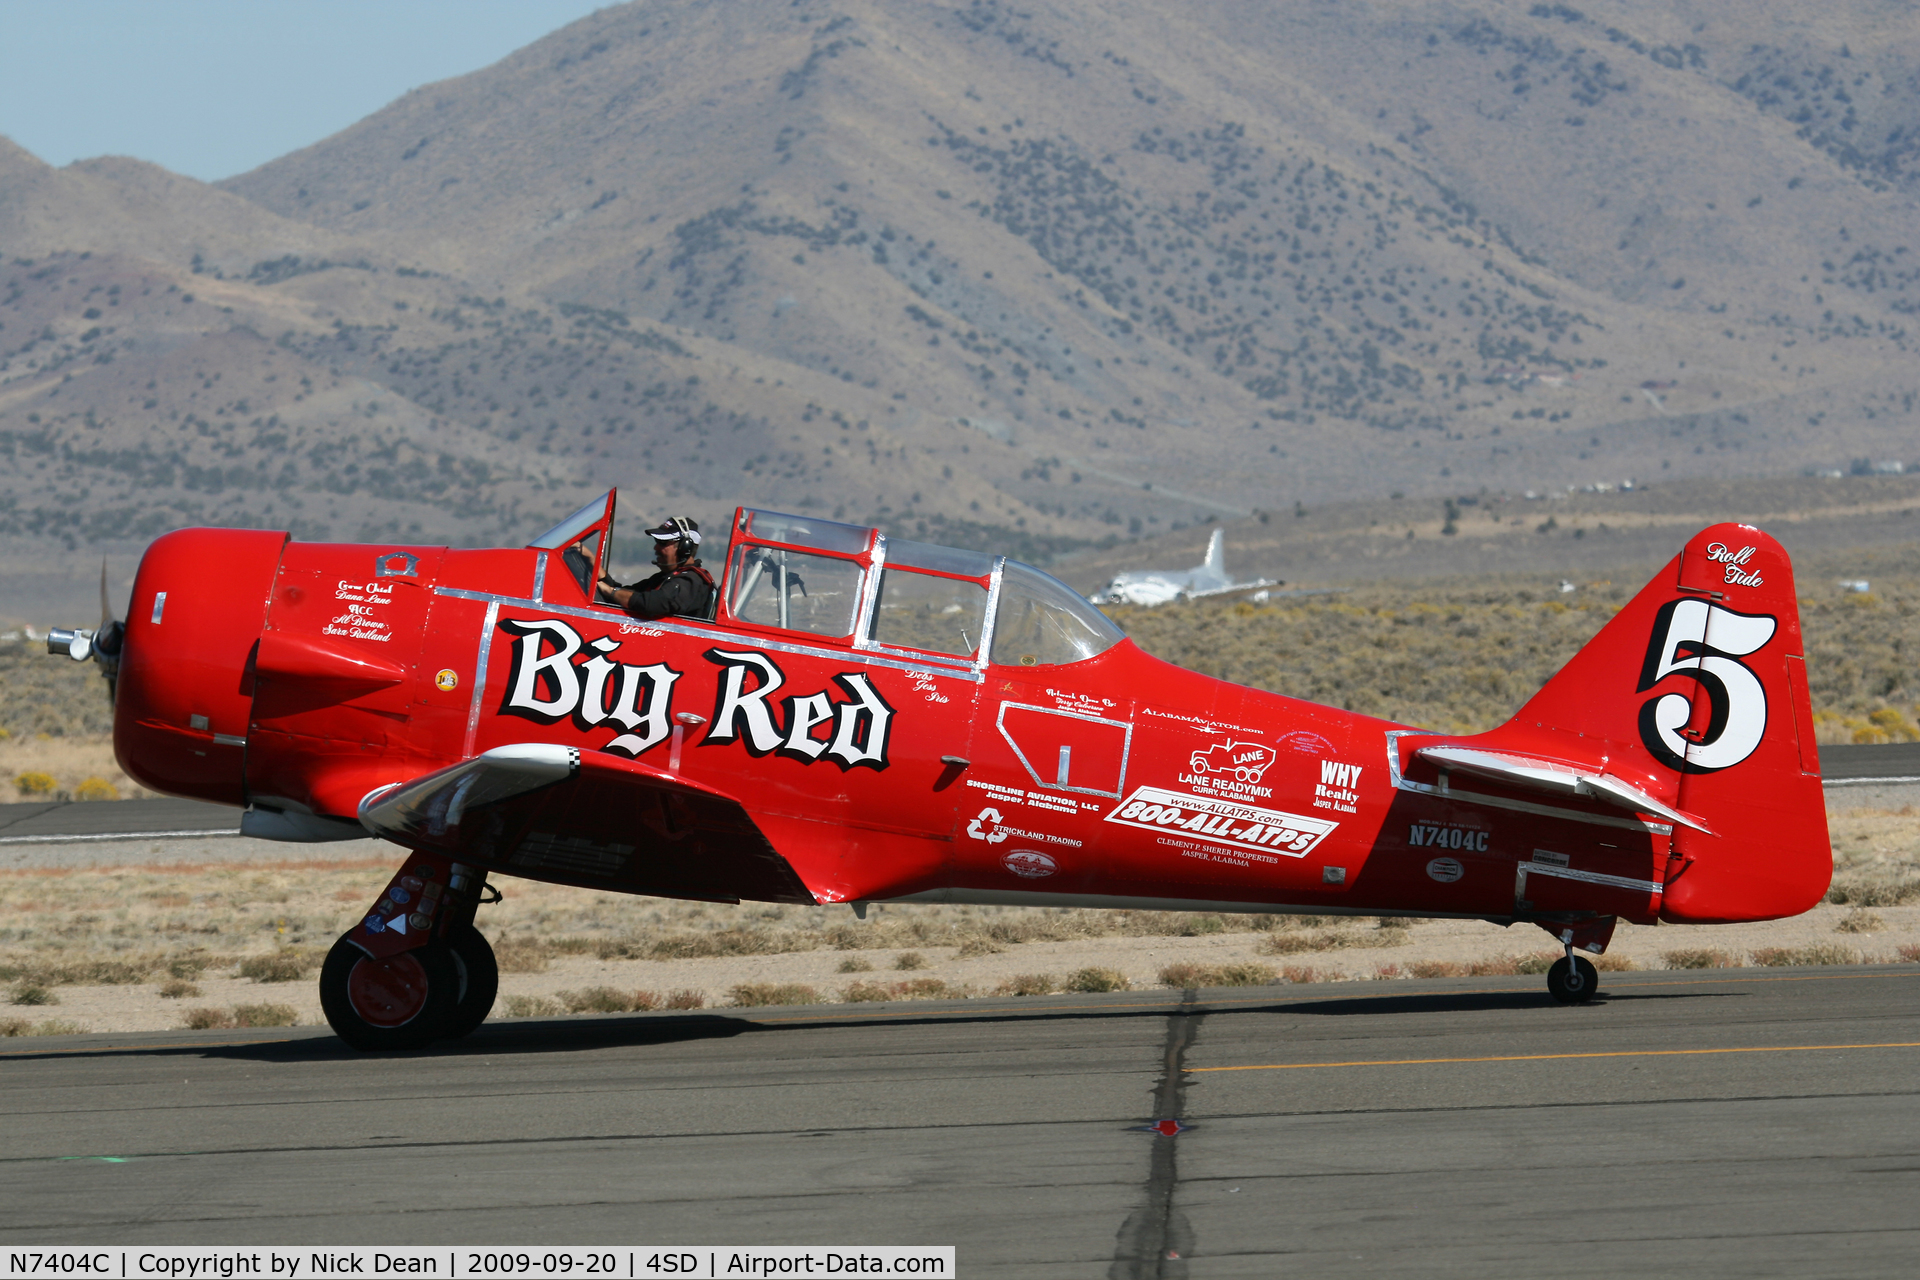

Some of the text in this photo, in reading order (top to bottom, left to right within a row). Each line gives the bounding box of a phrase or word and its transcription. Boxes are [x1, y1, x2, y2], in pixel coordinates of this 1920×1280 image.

[1707, 542, 1757, 566] Roll
[1724, 563, 1764, 587] Tide
[335, 590, 391, 604] Dana Lane
[366, 583, 393, 594] Chief
[348, 604, 373, 616] ACC
[351, 615, 385, 629] Brown
[619, 621, 665, 637] Gordo
[322, 624, 392, 642] Sara Rutland
[904, 669, 934, 681] Debs
[912, 680, 937, 691] Jess
[1638, 598, 1777, 772] 5
[500, 618, 895, 770] Big Red
[925, 692, 950, 704] Iris
[1078, 708, 1101, 716] Alabama
[1233, 750, 1265, 765] LANE
[1178, 772, 1273, 798] LANE READYMIX
[1321, 760, 1363, 789] WHY
[966, 779, 1100, 812] SHORELINE AVIATION, LLC
[985, 791, 1078, 815] Jasper, Alabama
[1192, 785, 1255, 802] CURRY, ALABAMA
[1315, 784, 1360, 805] Realty
[1169, 797, 1284, 826] www.ALLATPS.com
[993, 824, 1083, 848] STRICKLAND TRADING
[1120, 801, 1316, 851] 800-ALL-ATPS
[1408, 824, 1489, 852] N7404C
[1156, 837, 1195, 849] CLEMENT
[1202, 845, 1232, 856] SHERER
[1233, 851, 1279, 864] PROPERTIES
[1181, 849, 1250, 868] JASPER, ALABAMA
